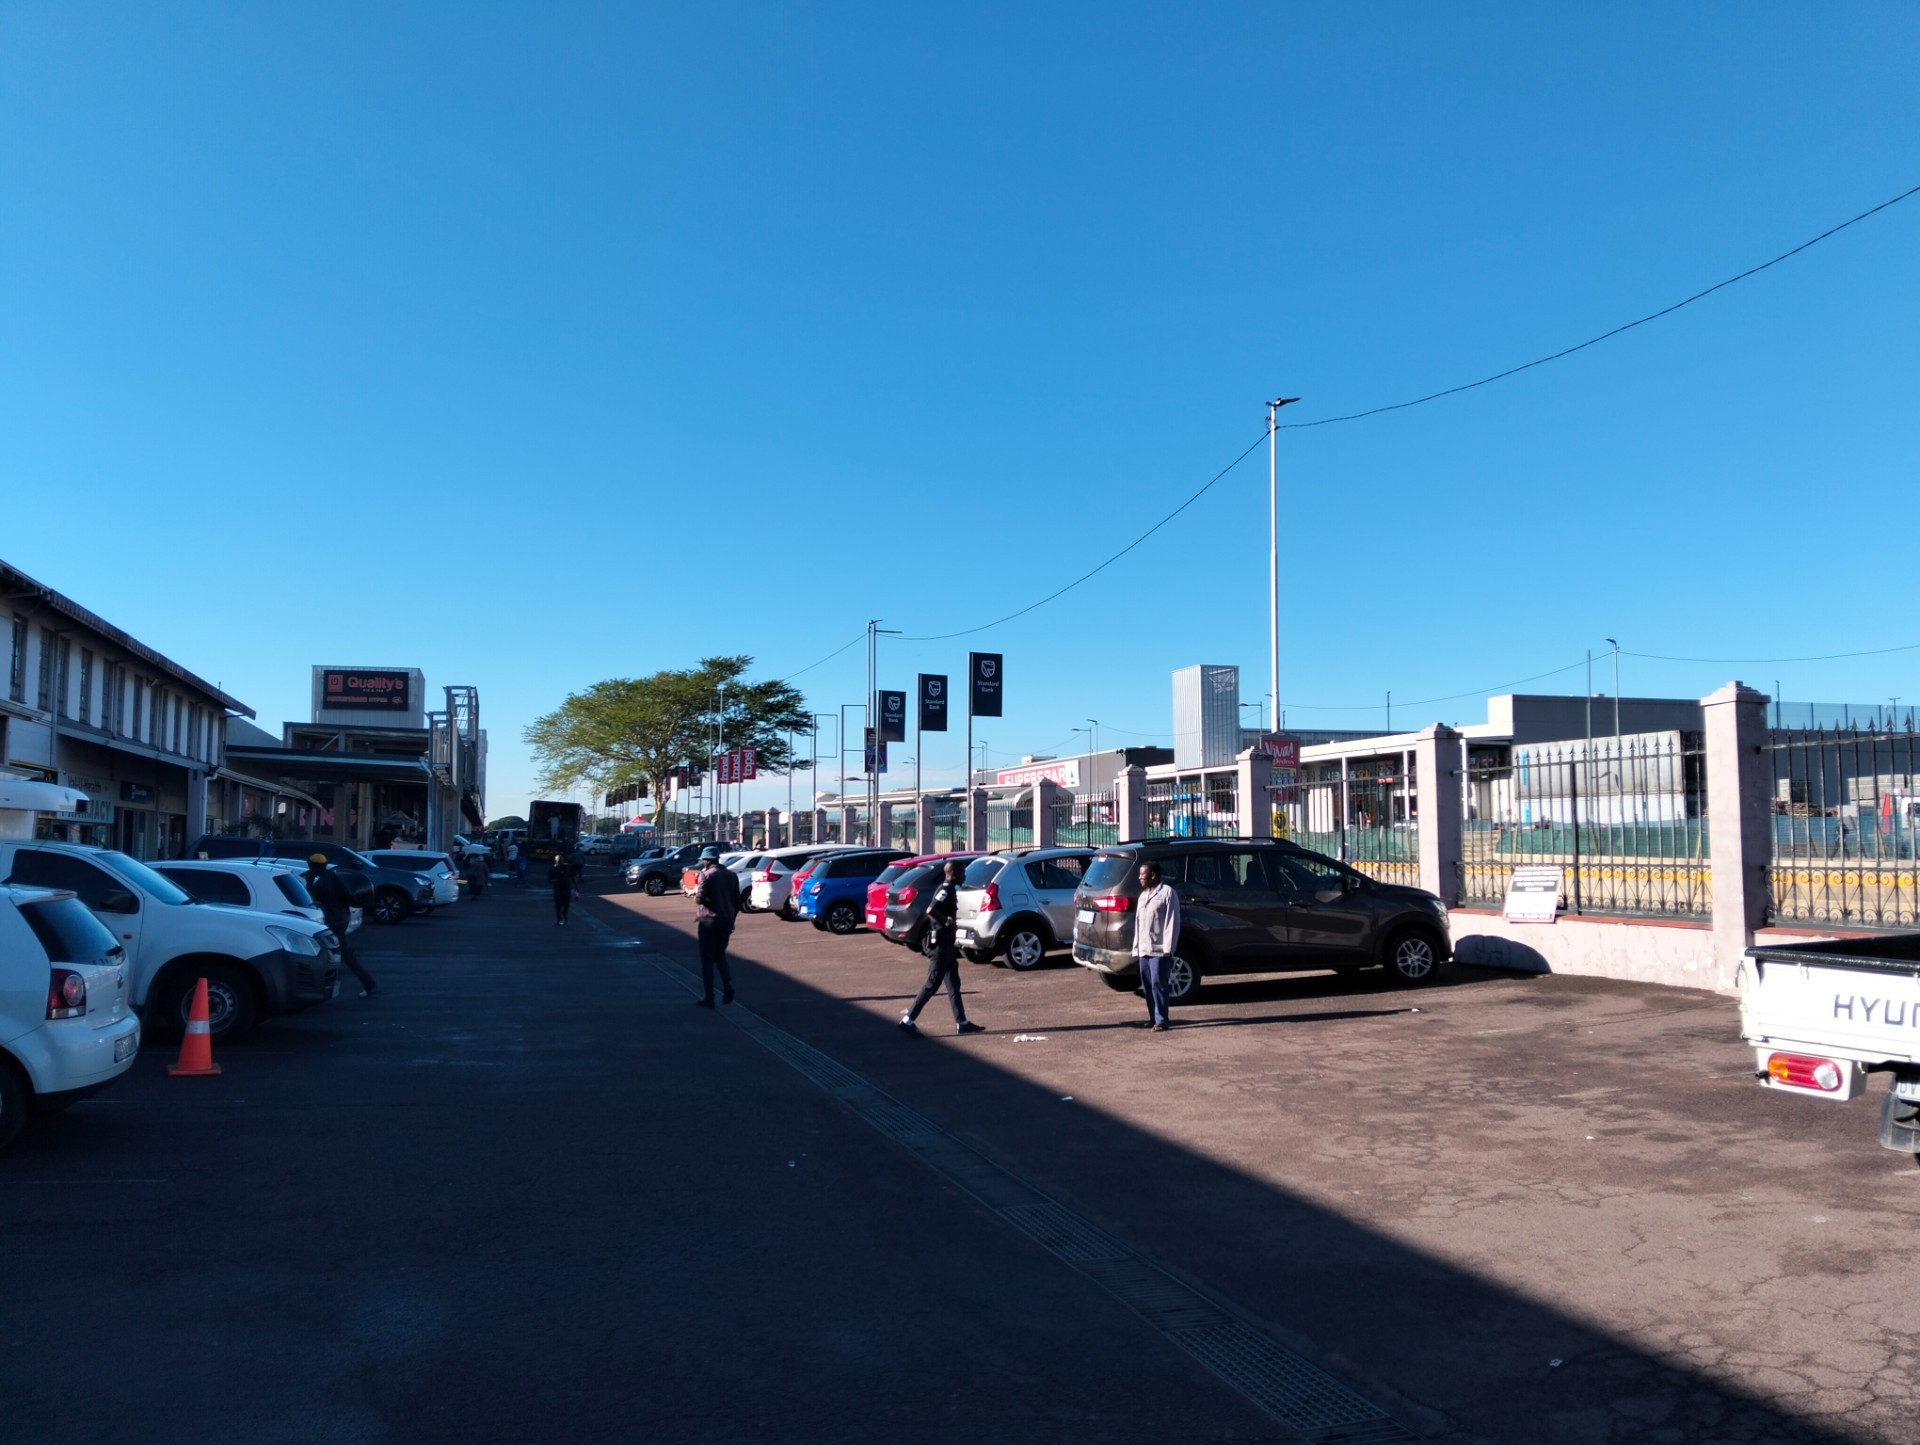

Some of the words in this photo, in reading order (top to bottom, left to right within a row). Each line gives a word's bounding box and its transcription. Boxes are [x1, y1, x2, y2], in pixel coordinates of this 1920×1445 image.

[347, 676, 404, 692] Quality's
[1264, 741, 1294, 759] Viva!
[743, 749, 755, 776] tops!
